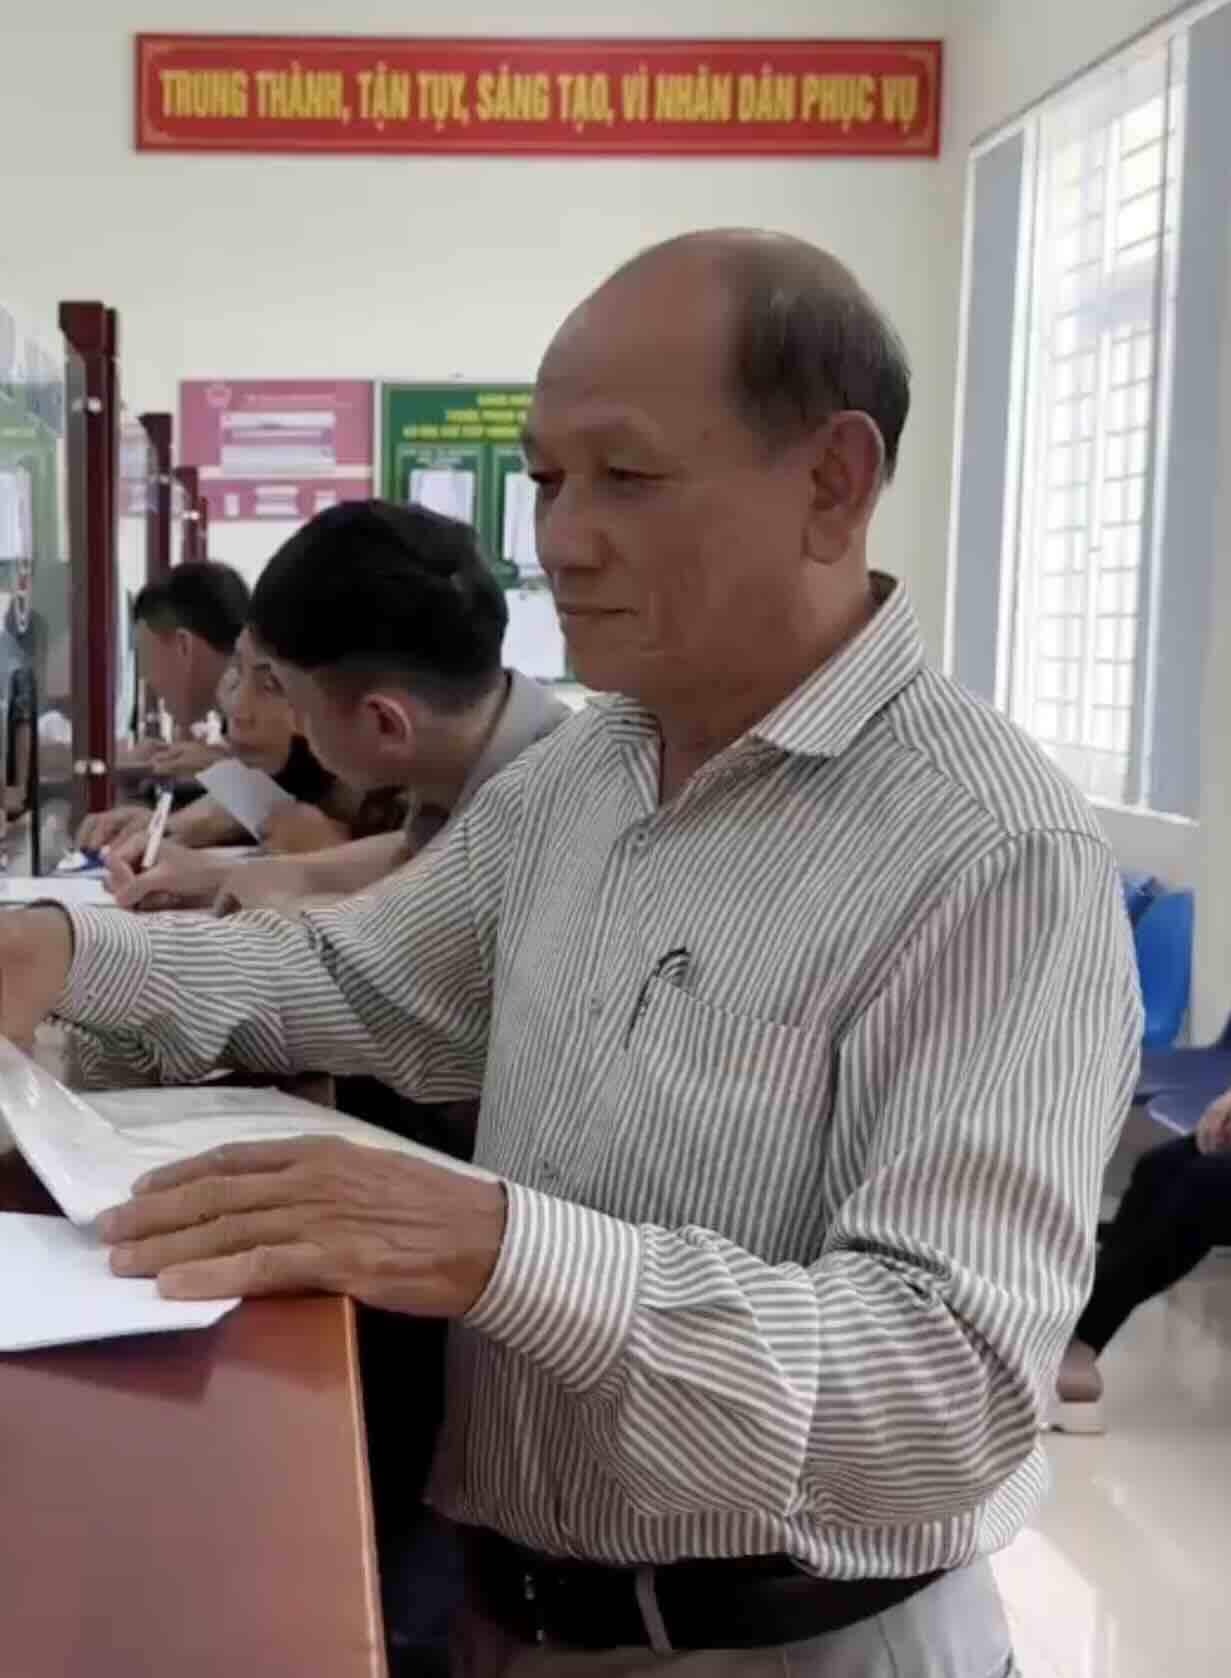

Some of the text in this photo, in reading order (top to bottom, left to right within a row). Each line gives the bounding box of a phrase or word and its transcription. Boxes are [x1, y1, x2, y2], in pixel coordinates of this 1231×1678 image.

[160, 69, 248, 118] TRUNG
[255, 61, 350, 125] THÀNH,
[356, 62, 410, 131] TẬN
[475, 63, 551, 120] SÁNG
[557, 70, 614, 132] TẠO,
[621, 65, 649, 120] VÌ
[654, 64, 732, 120] NHÂN
[738, 65, 796, 121] DÂN
[801, 73, 875, 131] PHỤC
[882, 74, 918, 132] VỤ
